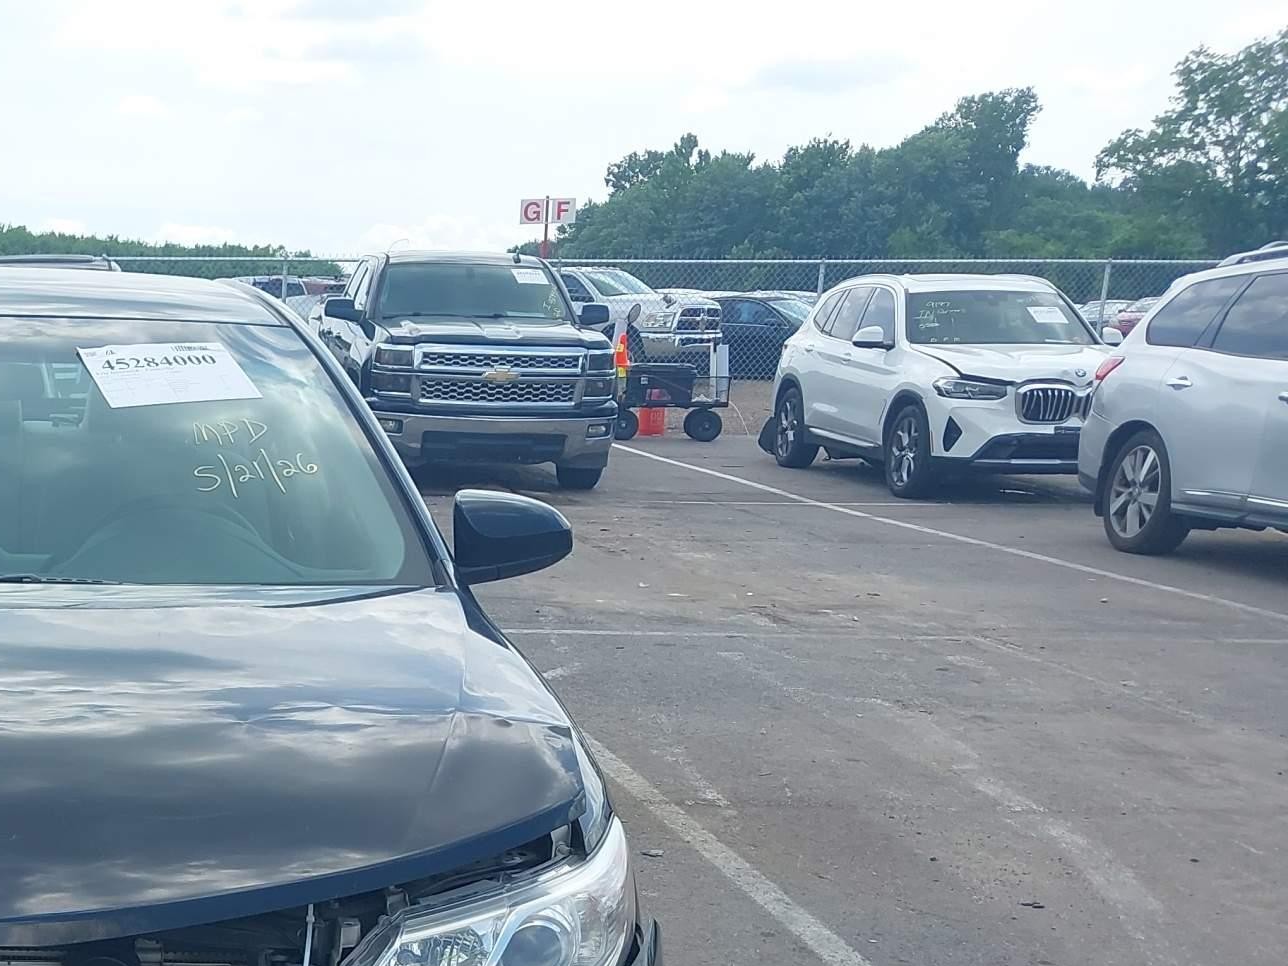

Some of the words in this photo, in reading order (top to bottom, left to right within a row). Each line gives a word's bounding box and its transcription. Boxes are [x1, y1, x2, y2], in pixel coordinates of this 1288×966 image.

[523, 201, 541, 221] G
[556, 201, 570, 220] F
[102, 354, 217, 371] 45284000
[193, 418, 268, 445] MPD
[193, 448, 318, 498] 5/21/26
